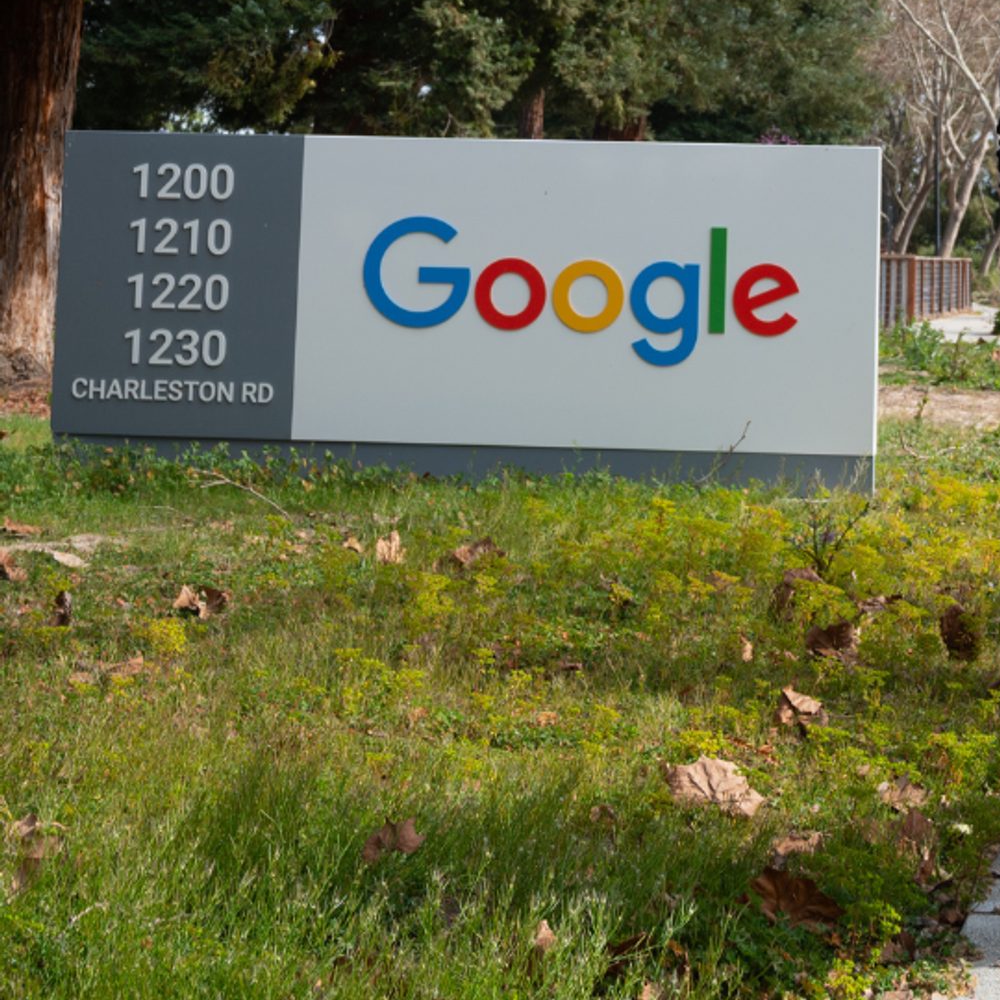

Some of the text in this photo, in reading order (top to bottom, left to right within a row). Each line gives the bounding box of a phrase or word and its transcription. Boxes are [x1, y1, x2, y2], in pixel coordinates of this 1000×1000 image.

[133, 162, 236, 200] 1200
[130, 217, 232, 255] 1210
[127, 272, 230, 311] 1220
[363, 216, 799, 367] Google
[124, 328, 227, 366] 1230
[71, 377, 274, 403] CHARLESTON RD
